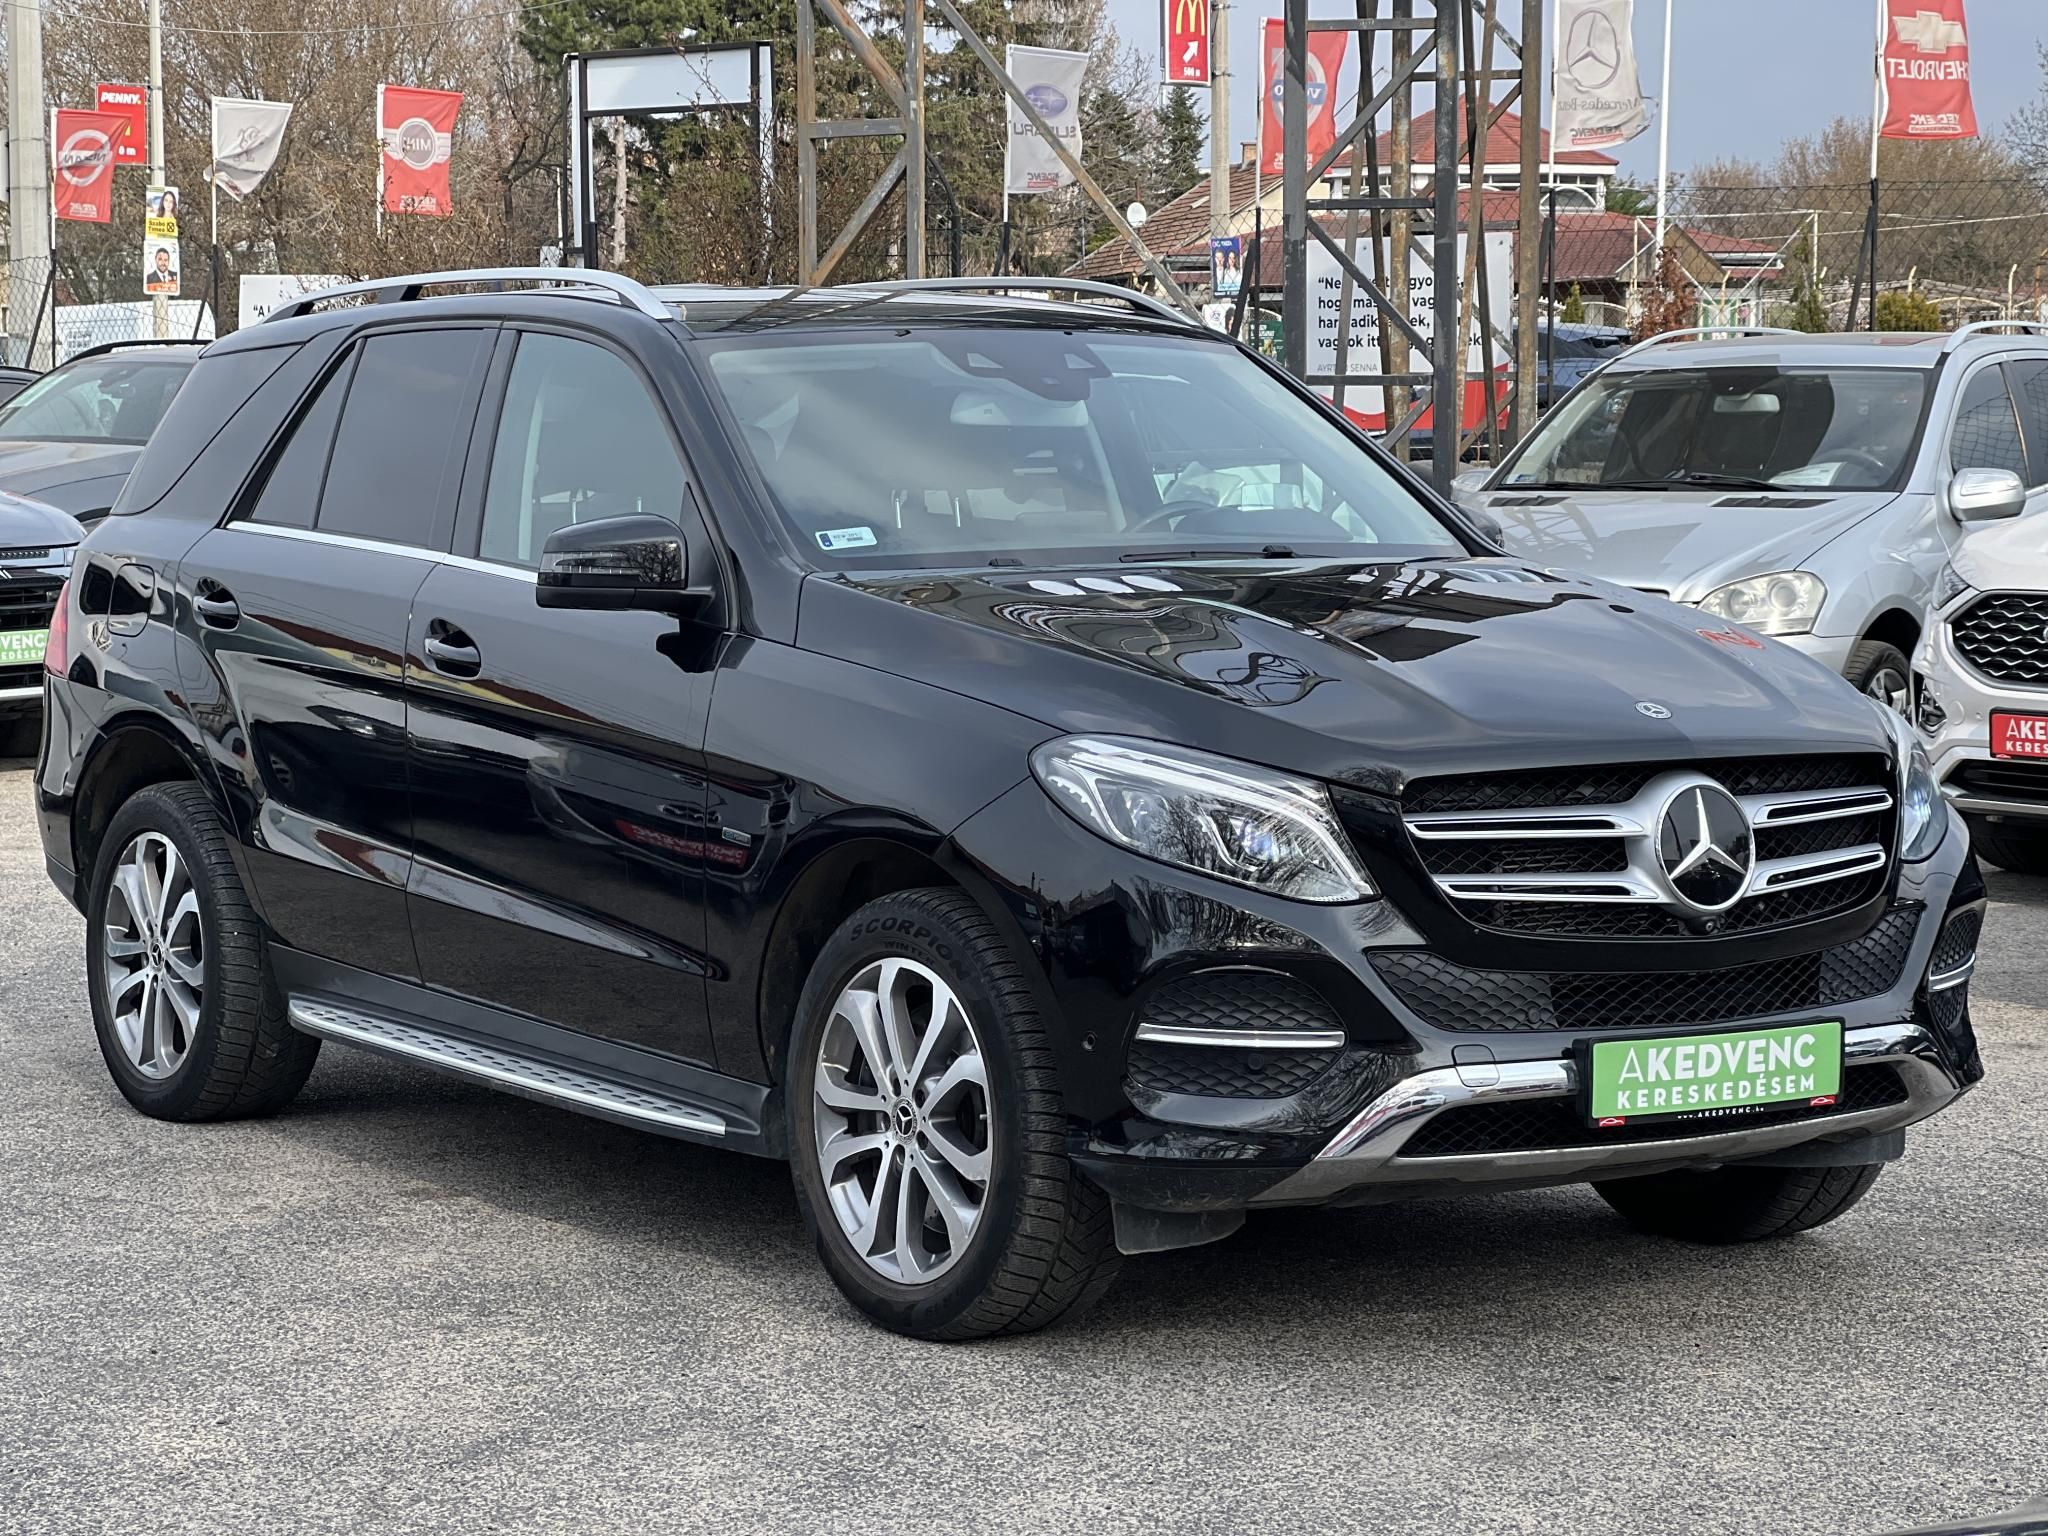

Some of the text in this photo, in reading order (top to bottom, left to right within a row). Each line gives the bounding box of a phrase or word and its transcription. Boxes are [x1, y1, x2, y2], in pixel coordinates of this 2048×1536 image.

[1318, 314, 1378, 329] haradik
[1318, 334, 1363, 350] vagok
[1350, 362, 1378, 373] SENNA
[1617, 1073, 1815, 1110] KERESKEDÉSEM
